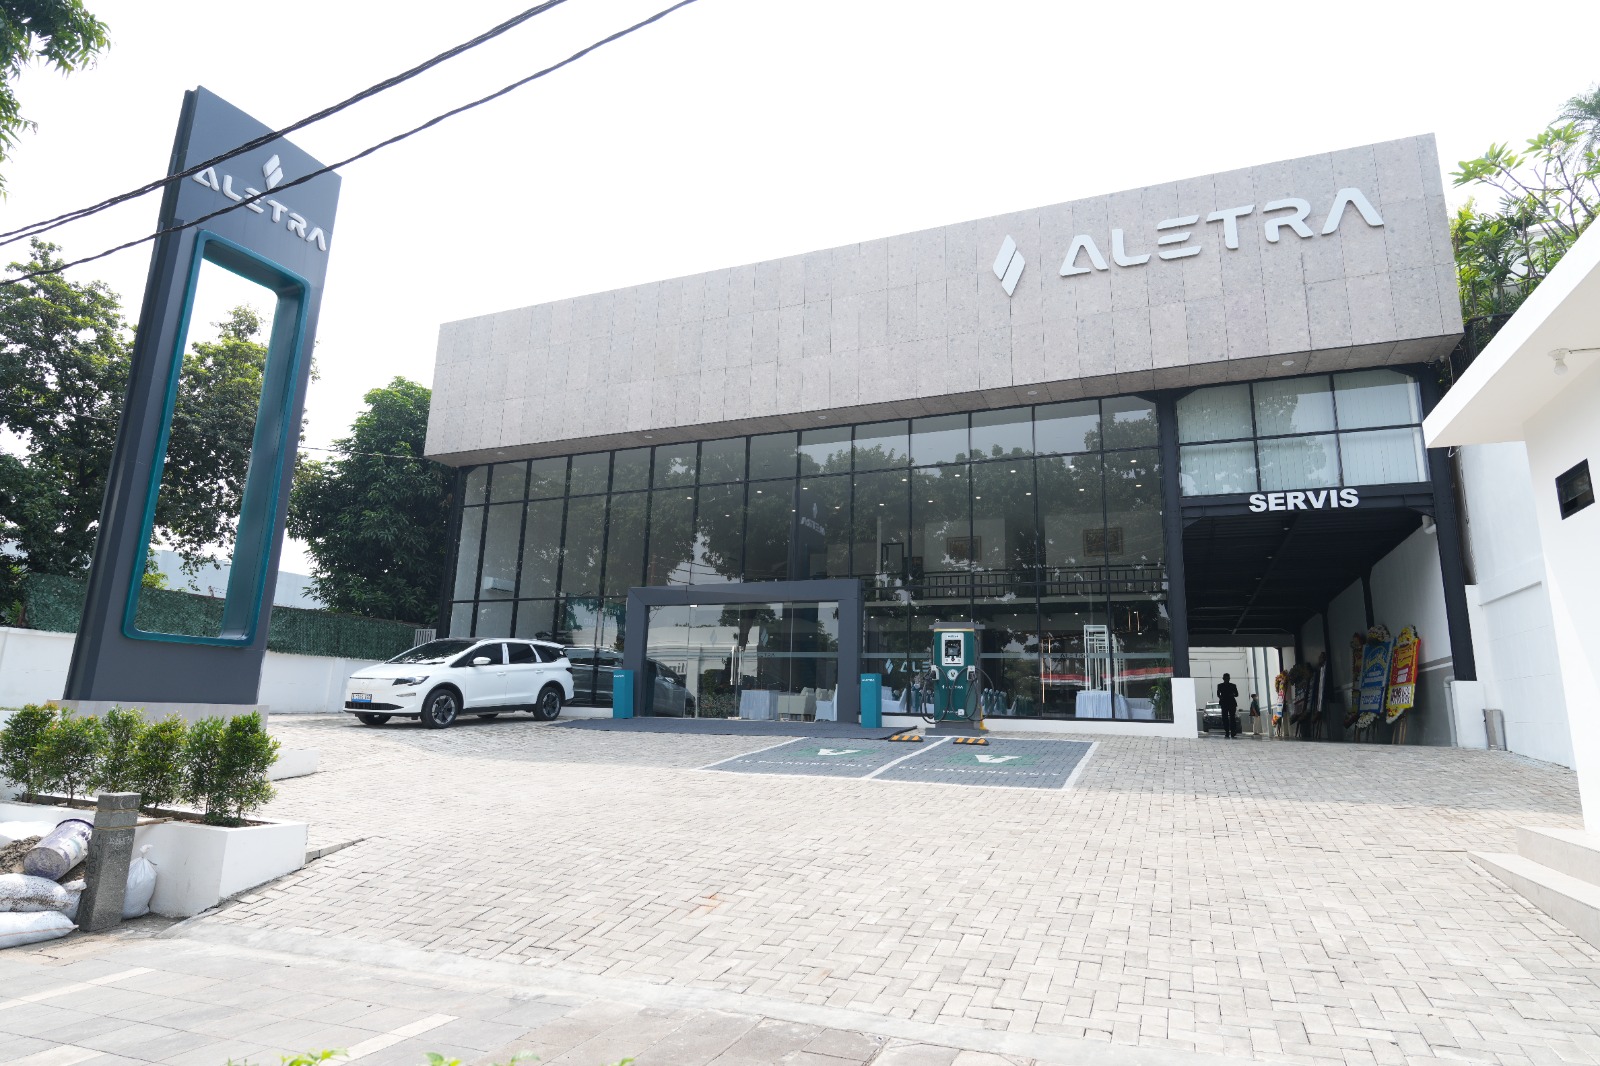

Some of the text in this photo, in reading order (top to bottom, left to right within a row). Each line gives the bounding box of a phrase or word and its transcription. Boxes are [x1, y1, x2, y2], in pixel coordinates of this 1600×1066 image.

[192, 166, 327, 252] ALETRA
[1059, 187, 1384, 277] ALETRA
[1248, 488, 1359, 513] SERVIS
